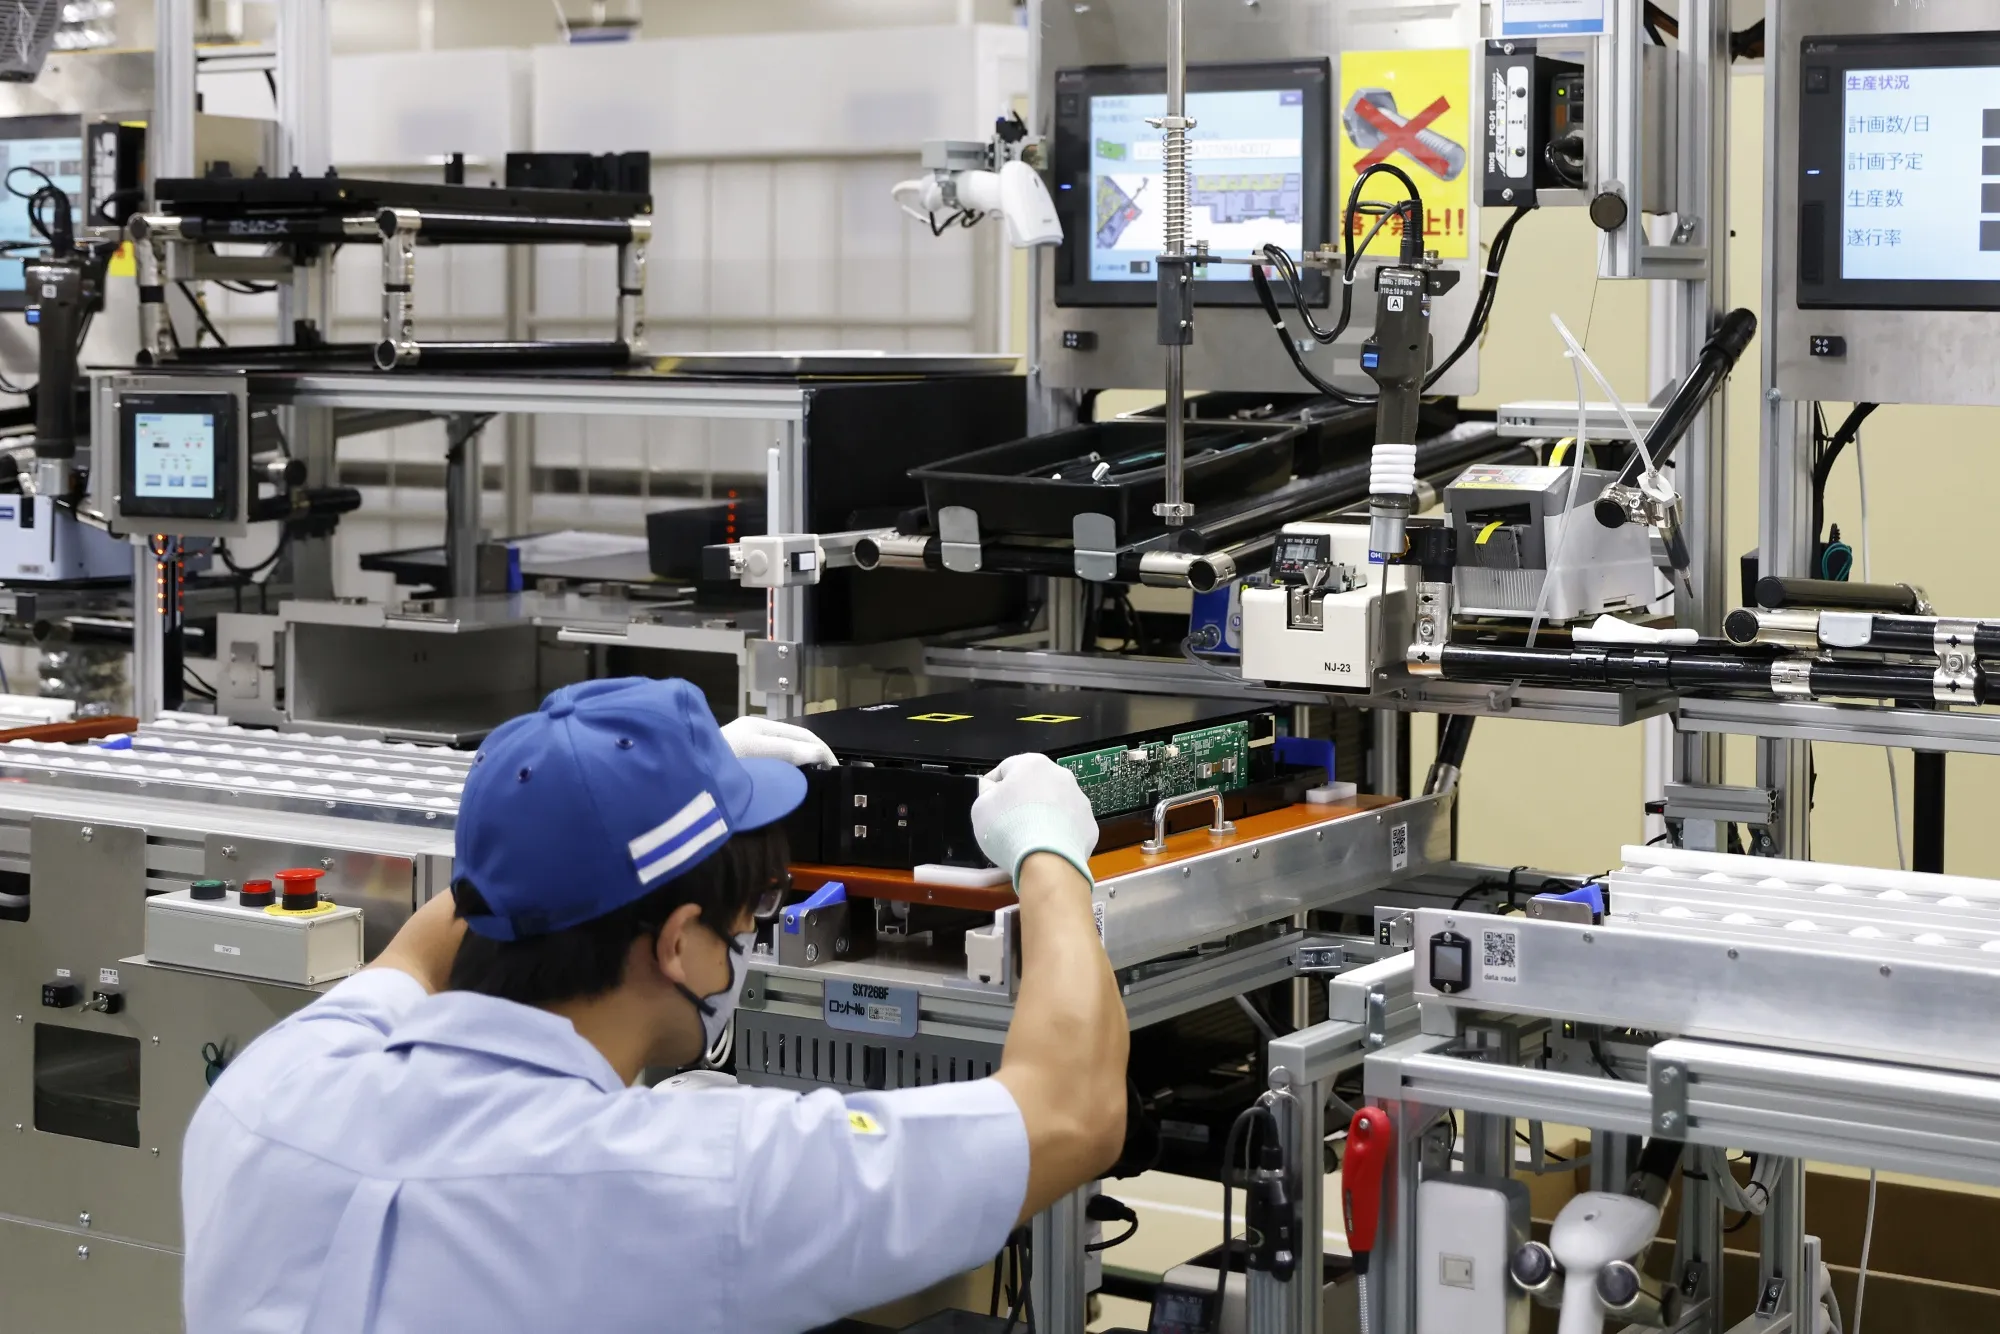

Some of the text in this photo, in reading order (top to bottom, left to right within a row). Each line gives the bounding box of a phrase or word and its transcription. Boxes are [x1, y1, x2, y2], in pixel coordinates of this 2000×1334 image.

[1846, 75, 1910, 91] 生産状況
[1848, 114, 1930, 134] 計画数/日
[1848, 152, 1923, 171] 計画予定
[1847, 189, 1904, 208] 生産数
[1846, 228, 1902, 247] 遂行率
[1392, 299, 1399, 308] A
[1324, 662, 1351, 673] NJ-23
[1484, 973, 1516, 983] data read
[852, 983, 889, 1000] SX726BF
[829, 999, 865, 1016] ロットNo
